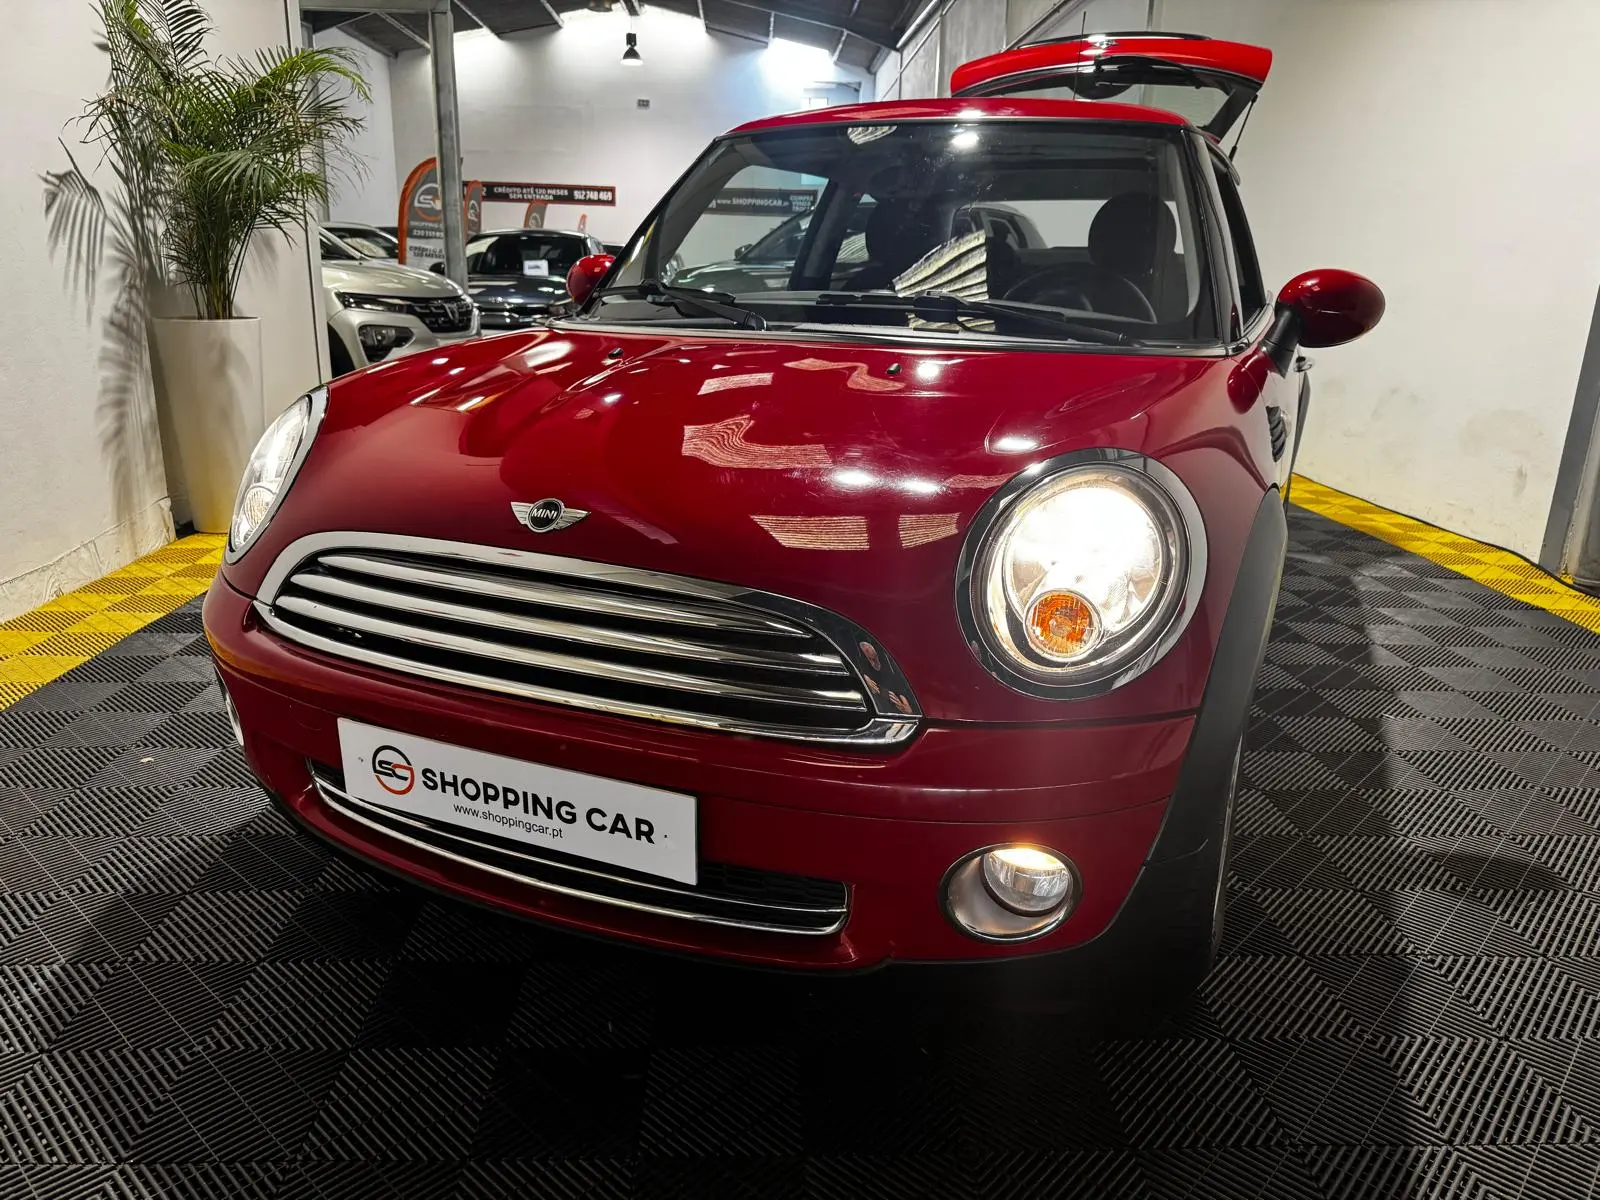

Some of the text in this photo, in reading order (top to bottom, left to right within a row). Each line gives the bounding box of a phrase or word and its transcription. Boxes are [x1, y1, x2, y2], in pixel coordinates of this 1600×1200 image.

[493, 186, 521, 194] CRÉDITO
[522, 186, 534, 194] ATÉ
[547, 188, 568, 196] MESES
[573, 190, 612, 201] 912 748 469
[531, 508, 558, 520] MINI
[421, 767, 656, 845] SHOPPING CAR
[453, 802, 564, 839] www.shoppingcar.pt
